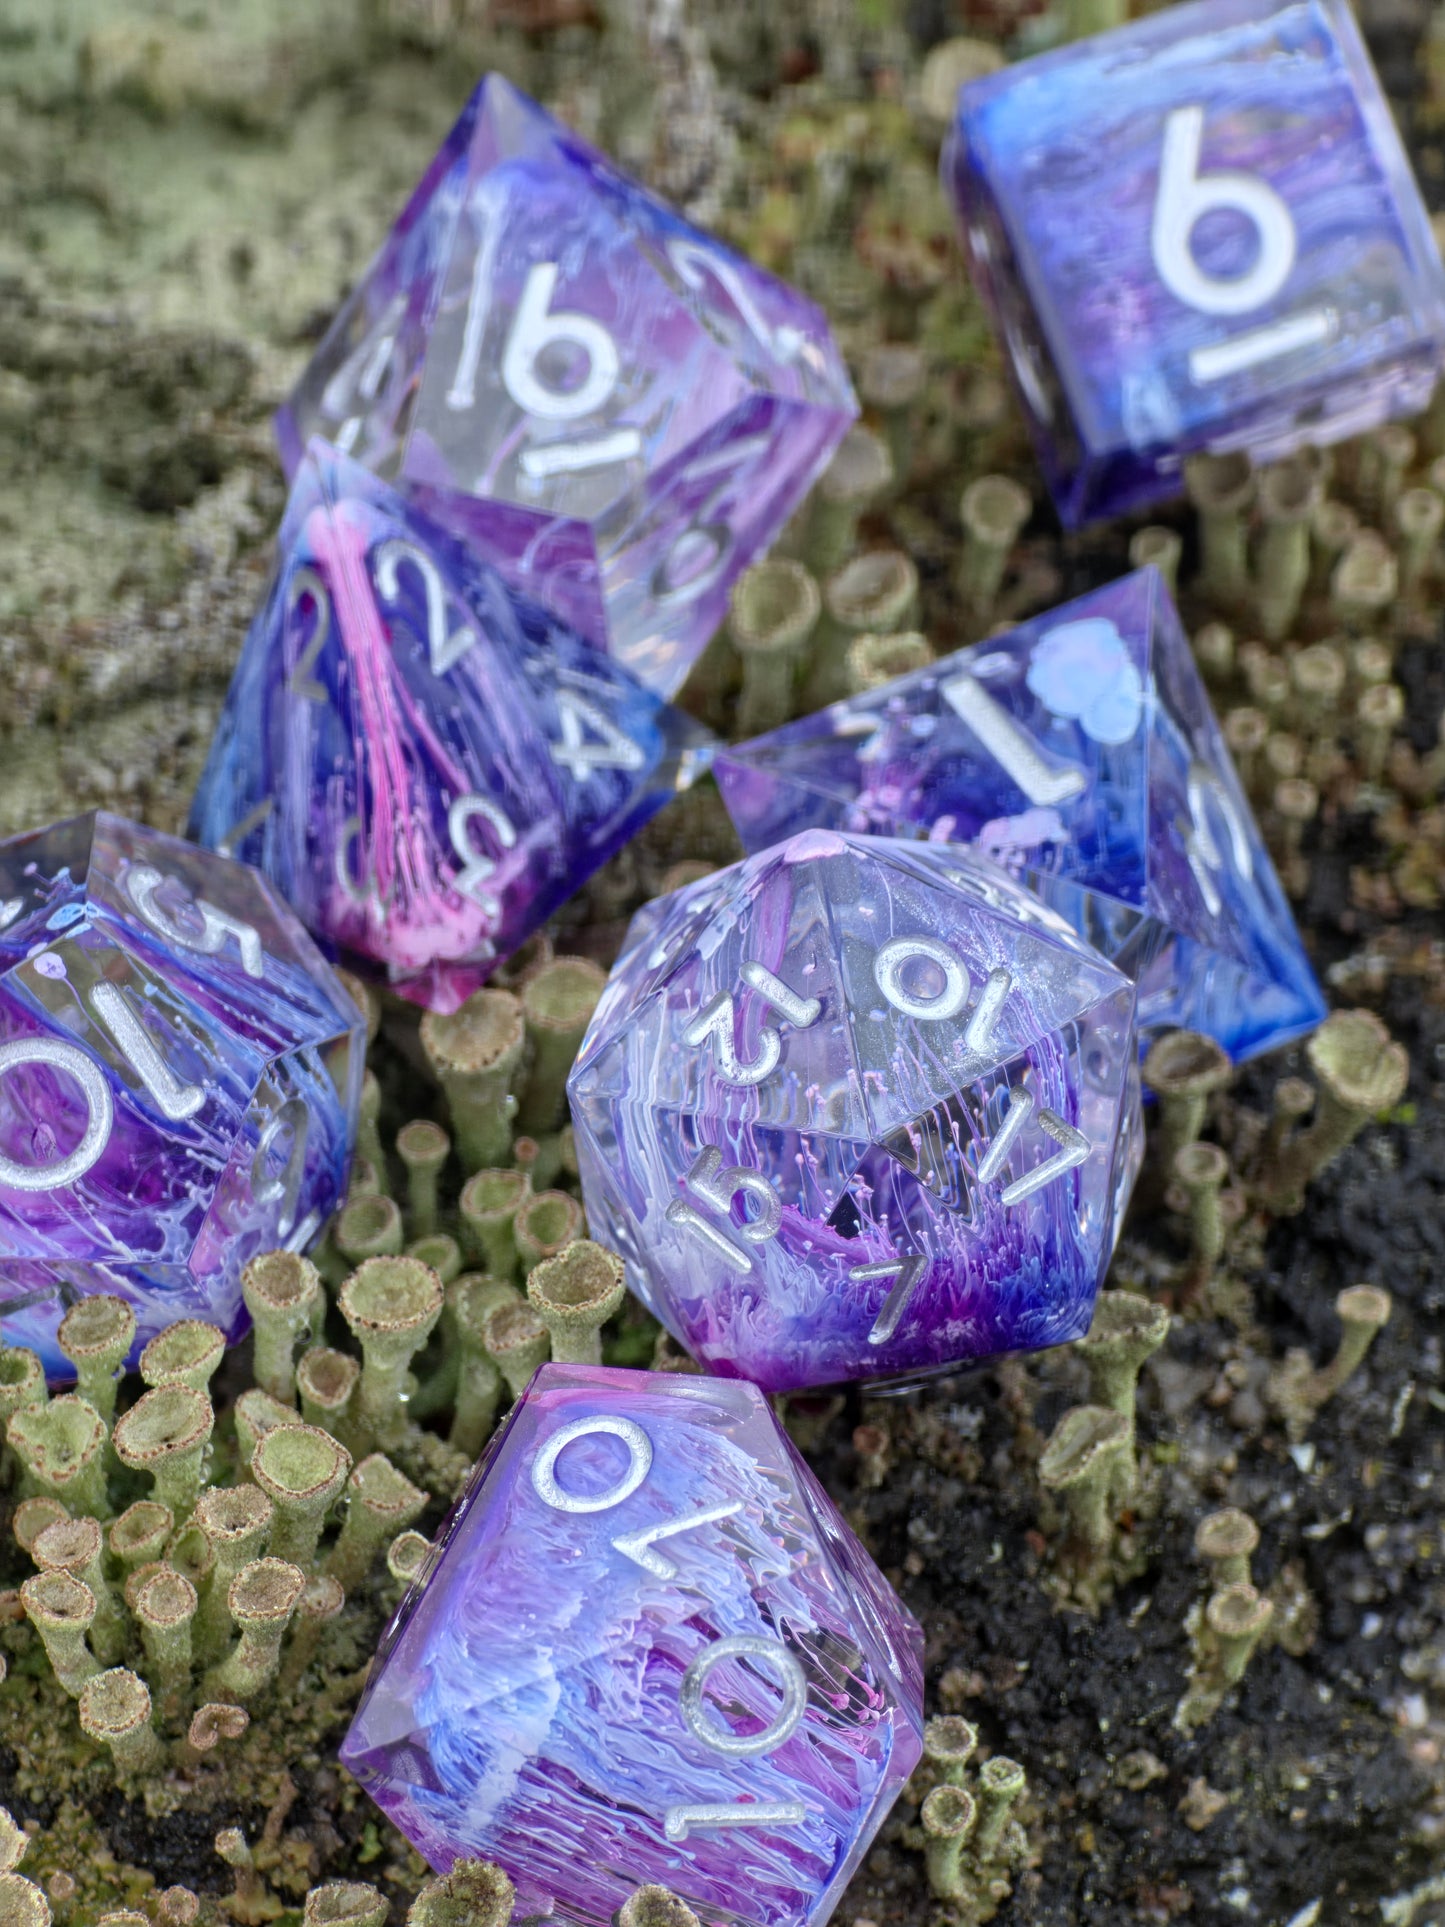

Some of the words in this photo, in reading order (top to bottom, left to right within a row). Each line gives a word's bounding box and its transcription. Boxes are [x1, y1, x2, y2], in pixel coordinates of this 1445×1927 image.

[1151, 106, 1305, 338] 6
[376, 540, 476, 676] 2
[550, 689, 644, 781] 4
[682, 959, 820, 1087] 12
[665, 1144, 782, 1274] 15
[977, 1084, 1091, 1207] 17
[848, 1254, 929, 1344] 7
